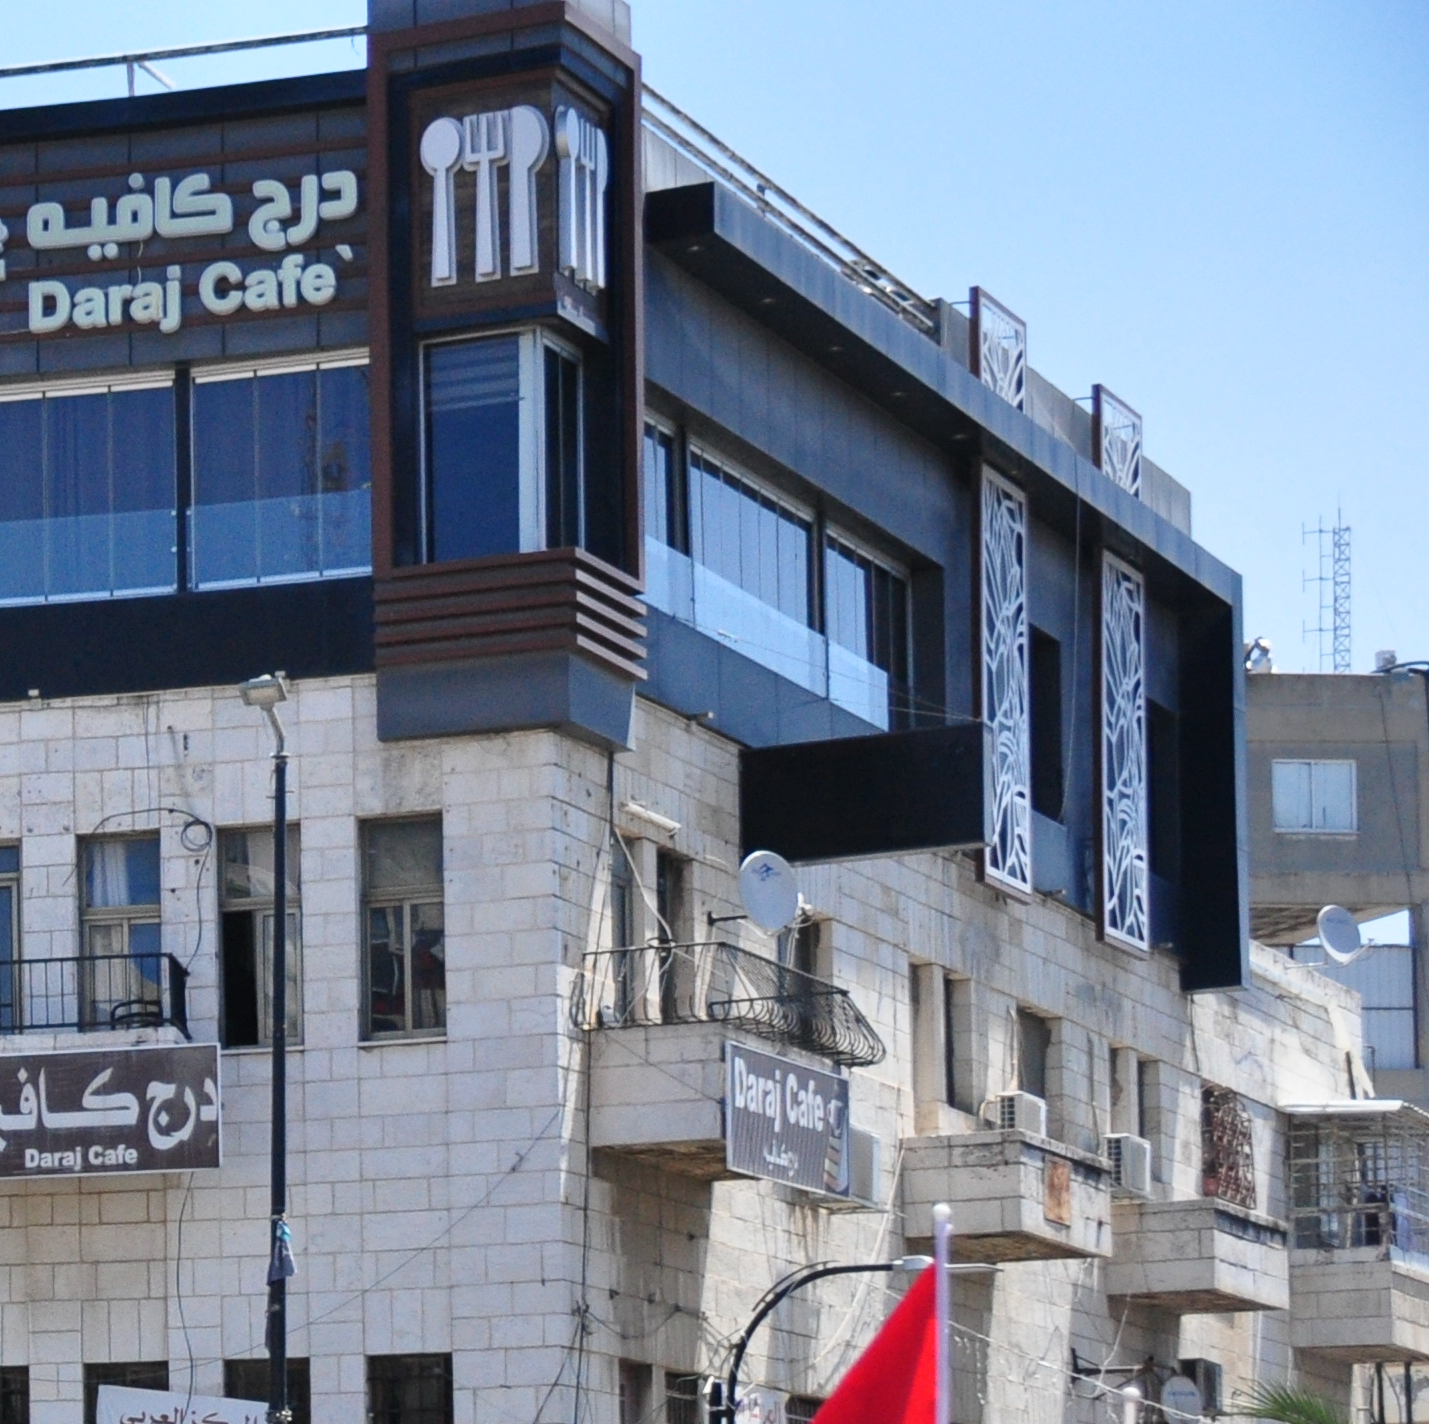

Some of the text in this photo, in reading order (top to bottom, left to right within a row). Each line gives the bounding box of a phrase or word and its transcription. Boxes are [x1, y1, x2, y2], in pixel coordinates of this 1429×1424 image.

[26, 169, 358, 261] درج كافيه
[28, 264, 181, 335] Daraj
[147, 1077, 216, 1150] درج
[734, 1056, 824, 1133] Daraj Cafe
[25, 1145, 138, 1171] Daraj Cafe
